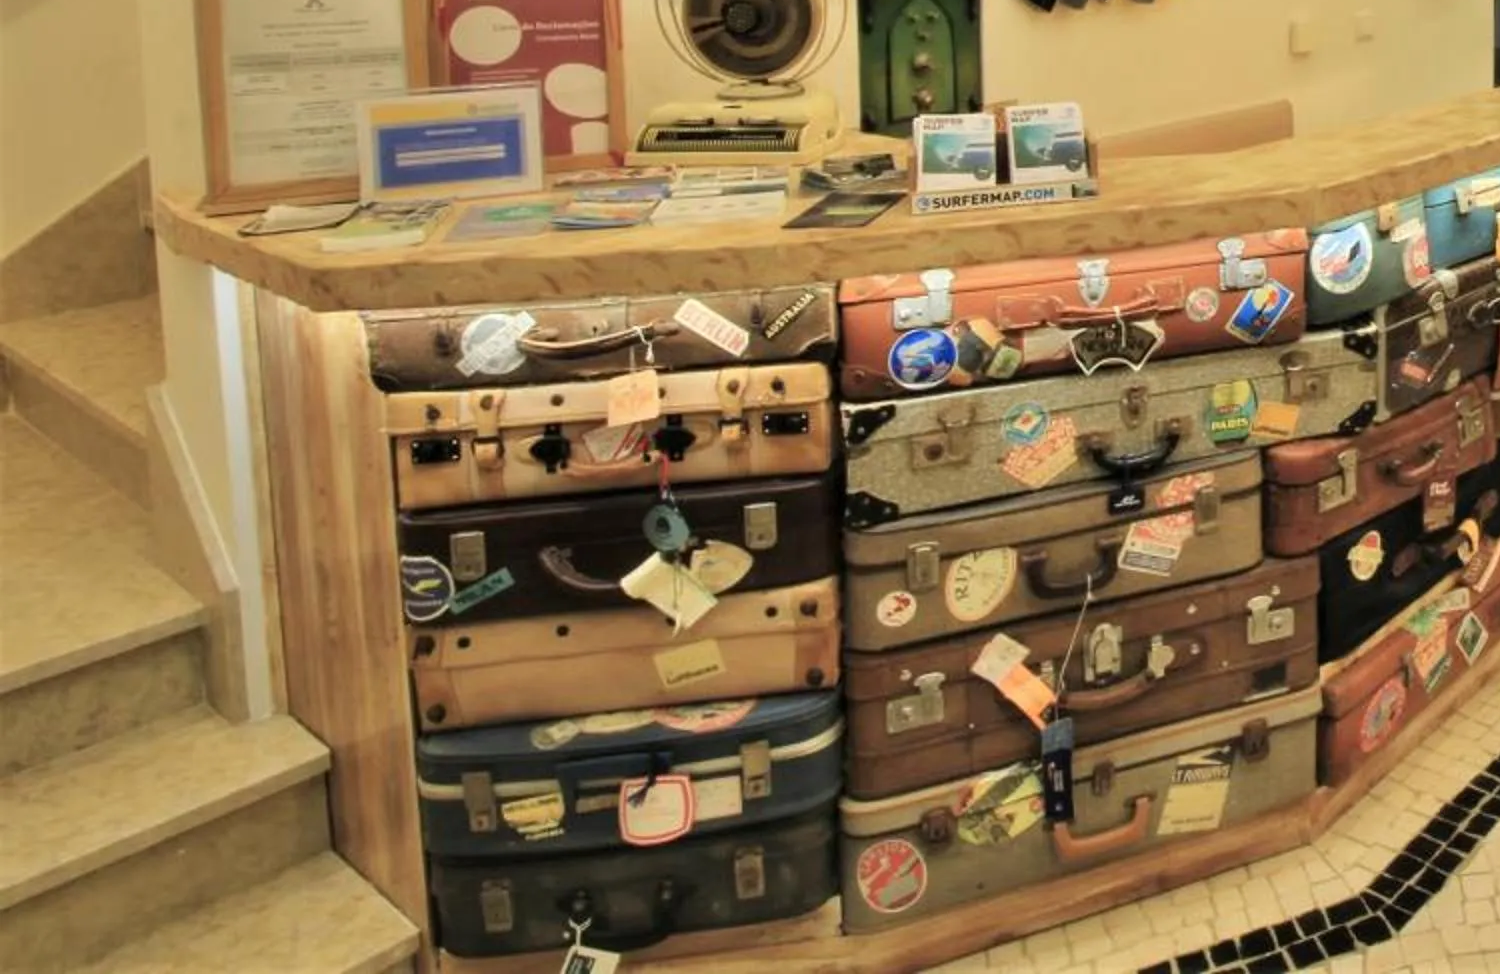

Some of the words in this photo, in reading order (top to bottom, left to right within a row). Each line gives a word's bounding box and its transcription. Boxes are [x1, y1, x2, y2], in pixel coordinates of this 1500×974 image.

[932, 188, 1054, 209] SURFERMAP.COM
[764, 292, 815, 339] AUSTRALIA
[1210, 417, 1249, 431] PARIS
